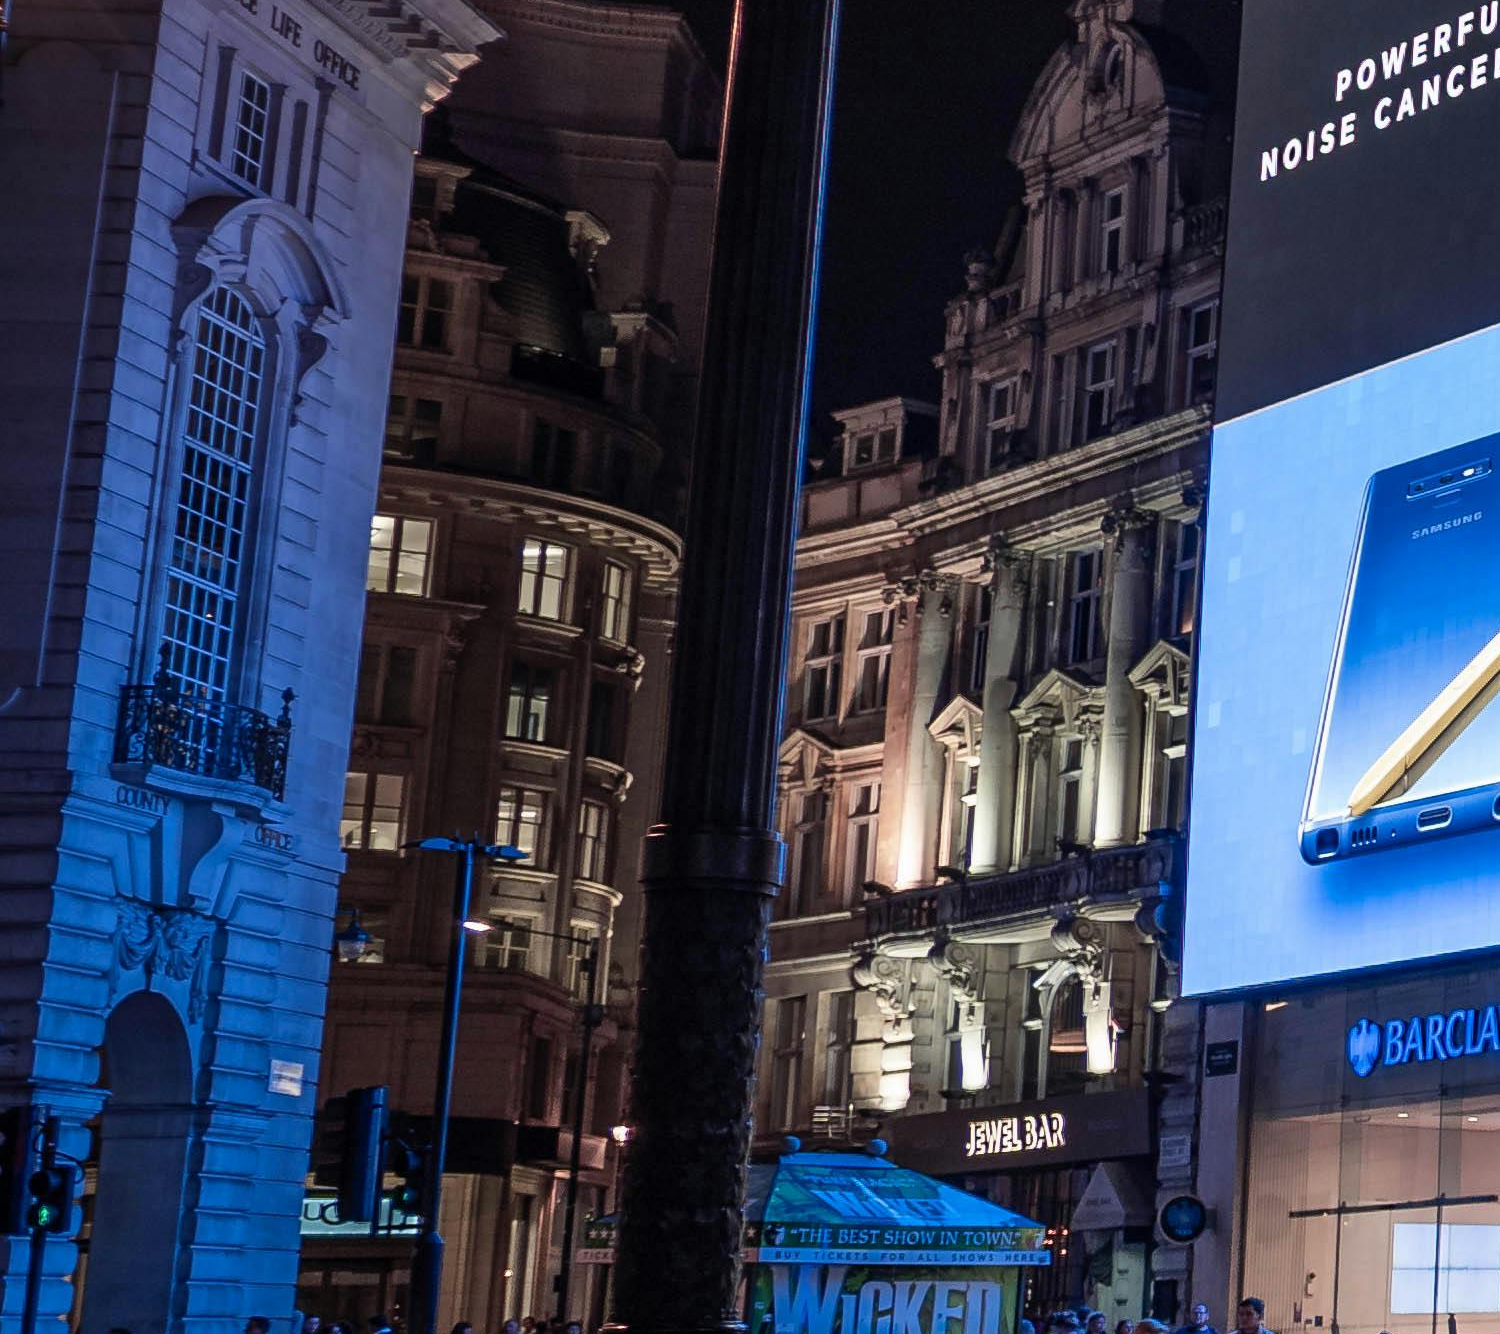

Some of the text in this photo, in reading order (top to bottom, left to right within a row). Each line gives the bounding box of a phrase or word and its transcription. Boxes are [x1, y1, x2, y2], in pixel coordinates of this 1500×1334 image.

[270, 4, 303, 50] LIFE
[313, 36, 361, 92] OFFICE
[1259, 111, 1358, 182] NOISE
[1410, 508, 1485, 542] SAMSUNG
[115, 784, 294, 852] COUNTY OFFICE
[965, 1111, 1067, 1159] JEWEL BAR
[774, 1250, 1036, 1264] BUY TICKETS FOR ALL SHOWS HERE
[838, 1228, 881, 1245] BEST
[883, 1229, 936, 1247] SHOW
[939, 1230, 960, 1246] IN
